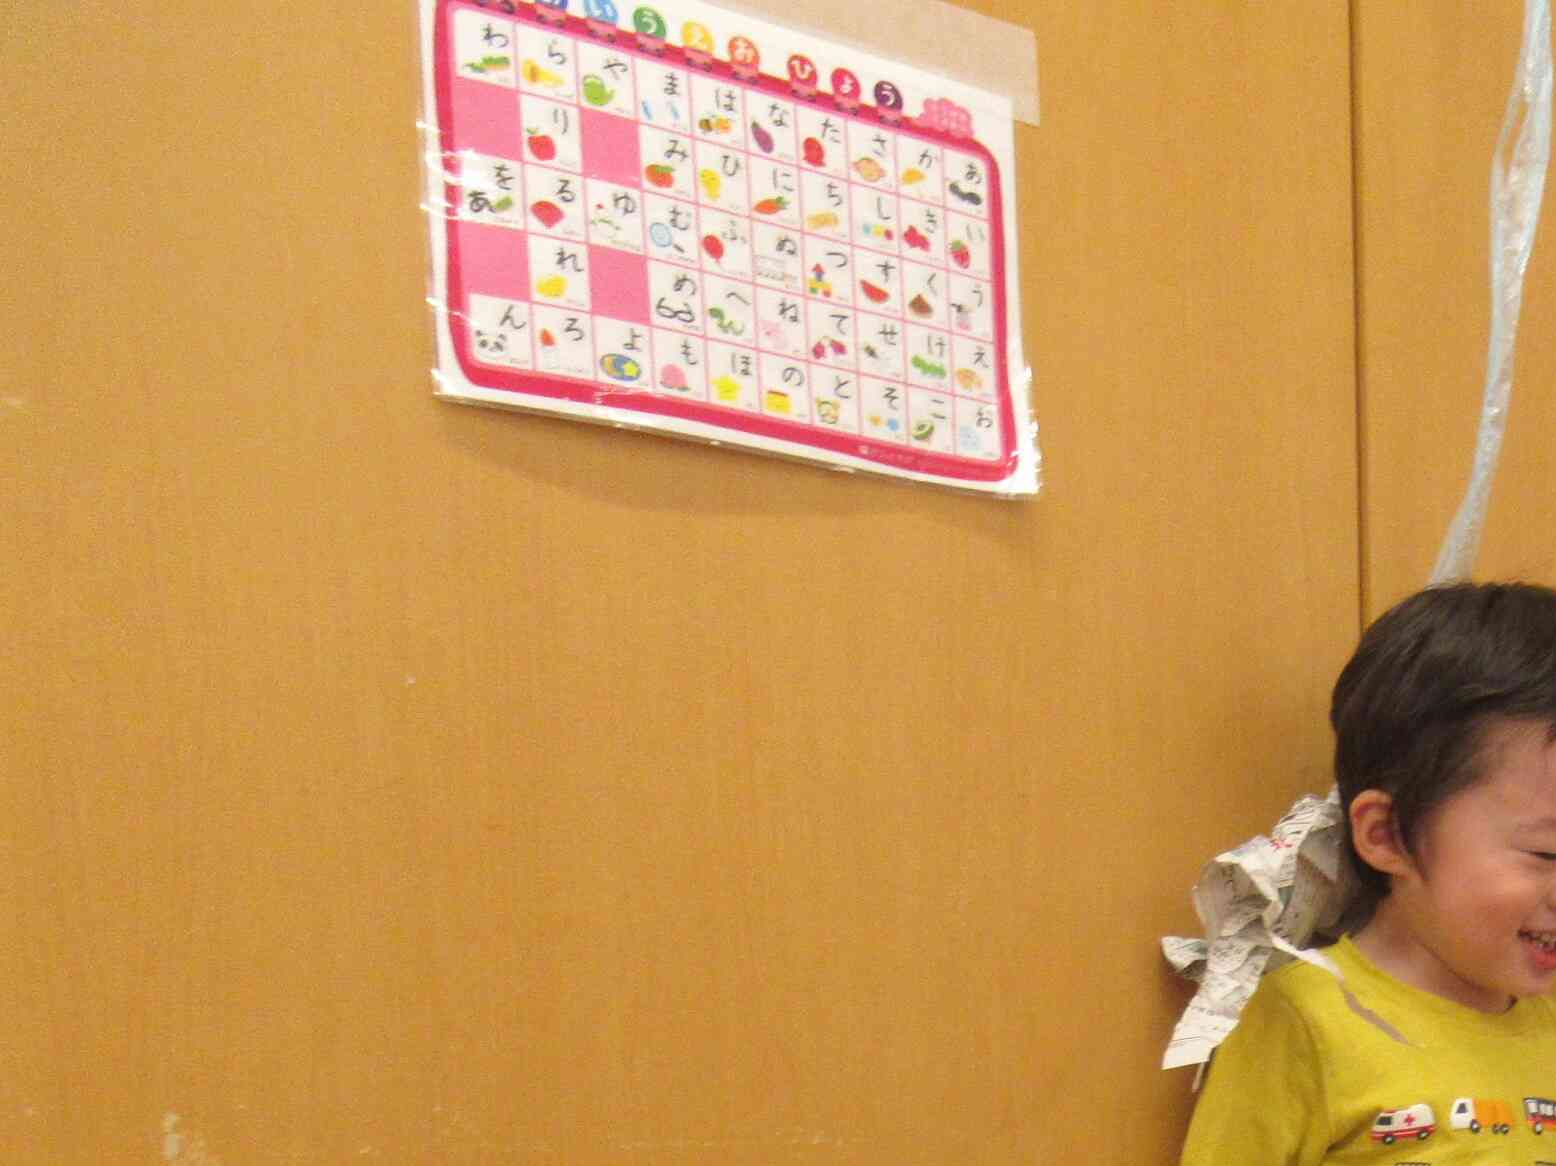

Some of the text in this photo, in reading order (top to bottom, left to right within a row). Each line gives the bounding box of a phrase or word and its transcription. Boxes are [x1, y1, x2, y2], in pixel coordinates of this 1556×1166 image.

[483, 24, 509, 48] わ
[548, 41, 567, 64] ら
[603, 59, 629, 80] や
[664, 75, 681, 95] ま
[715, 89, 737, 111] は
[553, 110, 569, 135] り
[769, 103, 790, 128] な
[821, 118, 841, 143] た
[664, 140, 688, 160] み
[718, 154, 743, 178] ひ
[493, 165, 515, 191] を
[772, 168, 793, 192] に
[556, 180, 575, 202] る
[613, 193, 637, 215] ゆ
[876, 196, 891, 220] し
[669, 206, 691, 231] む
[776, 237, 798, 255] ぬ
[555, 248, 584, 273] れ
[826, 252, 848, 268] つ
[673, 274, 697, 296] め
[500, 306, 526, 330] ん
[778, 301, 800, 324] ね
[828, 313, 850, 334] て
[565, 318, 587, 341] ろ
[623, 328, 642, 351] よ
[879, 324, 899, 346] せ
[680, 341, 699, 365] も
[731, 353, 753, 377] ほ
[782, 366, 805, 387] の
[833, 377, 852, 399] と
[882, 386, 900, 410] そ
